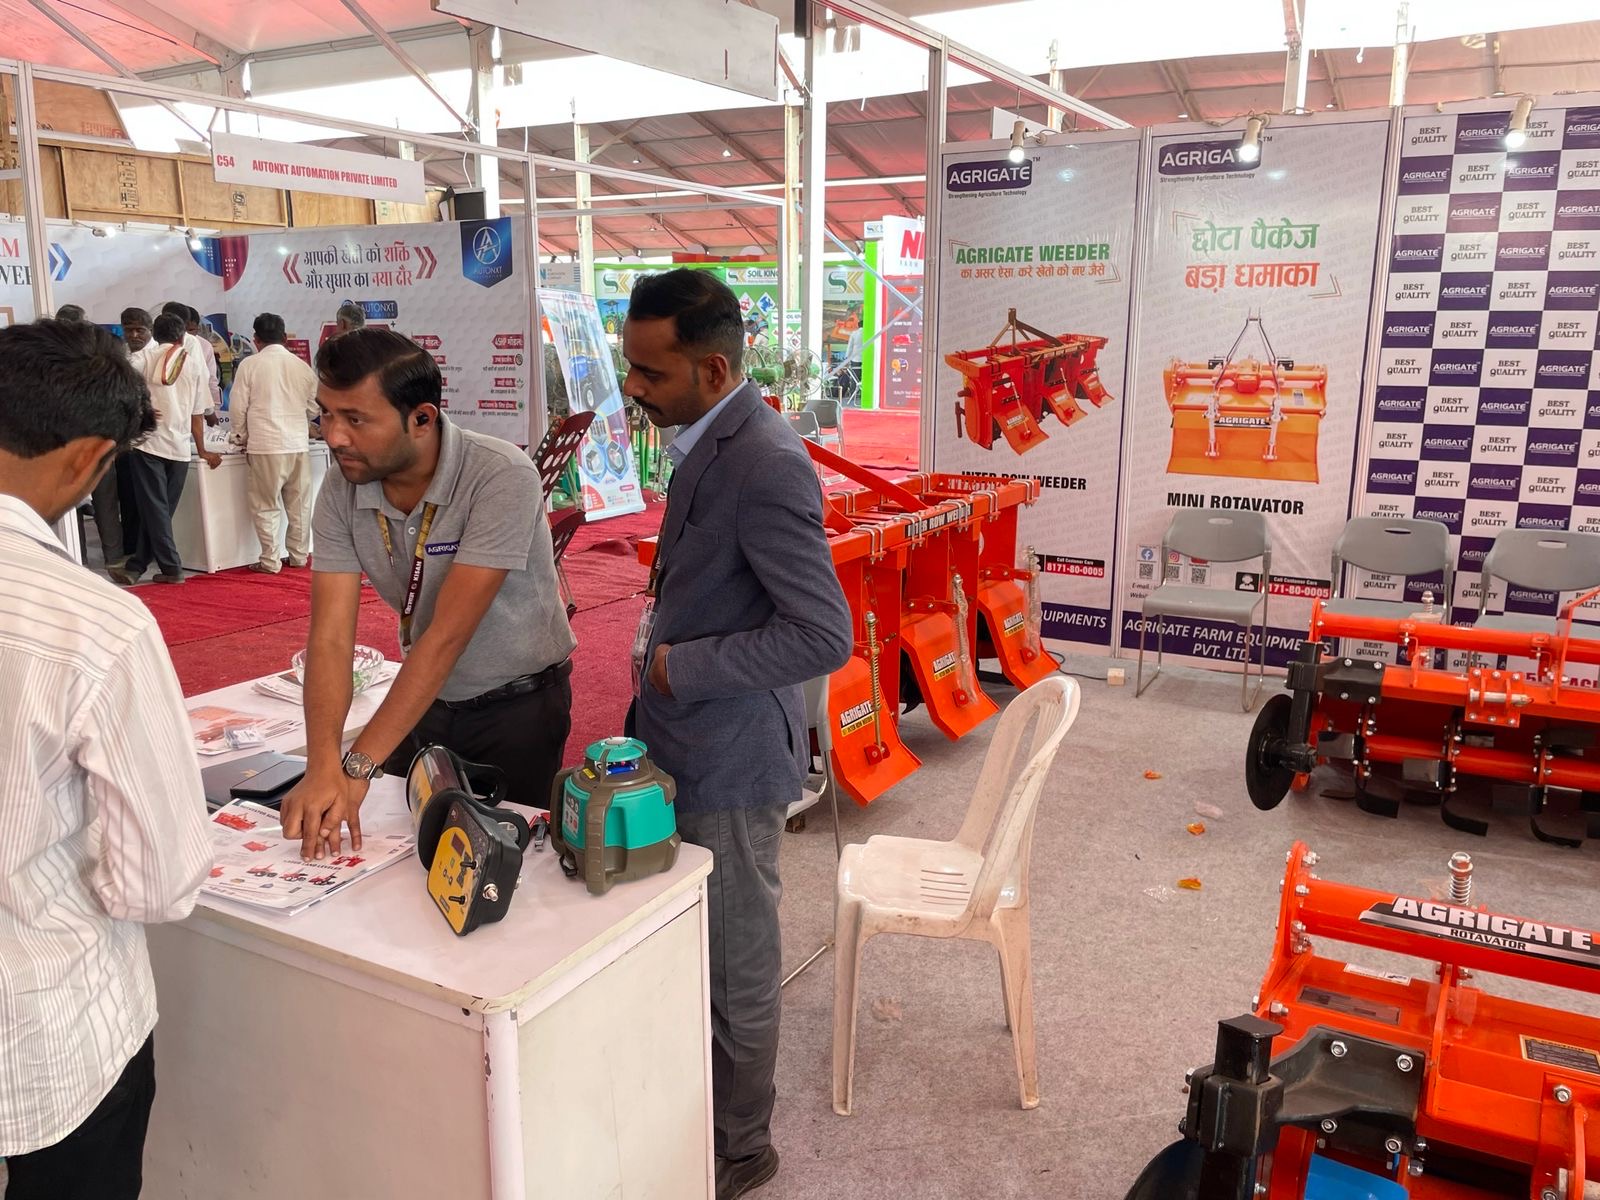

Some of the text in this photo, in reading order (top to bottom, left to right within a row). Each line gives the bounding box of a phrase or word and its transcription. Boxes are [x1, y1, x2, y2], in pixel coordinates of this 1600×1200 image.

[1567, 123, 1600, 132] AGRIGA
[1459, 128, 1504, 137] AGRIGATE
[1412, 135, 1447, 145] QUALITY
[216, 154, 235, 168] C54
[1162, 148, 1258, 168] AGRIGA
[252, 160, 398, 188] AUTONXT AUTOMATION PRIVATE LIMITED
[949, 166, 1030, 184] AGRIGATE
[1403, 171, 1447, 180] AGRIGATE
[1508, 167, 1554, 175] AGRIGATE
[1568, 170, 1600, 179] QUALIT
[1459, 173, 1495, 183] QUALITY
[1451, 208, 1495, 216] AGRIGATE
[1509, 211, 1545, 221] QUALITY
[1403, 215, 1438, 223] QUALITY
[1191, 217, 1320, 251] छोटा पैकेज
[304, 245, 338, 266] आपकी
[365, 242, 381, 263] को
[956, 243, 1110, 264] AGRIGATE WEEDER
[1395, 249, 1438, 257] AGRIGATE
[1500, 247, 1545, 255] AGRIGATE
[1558, 251, 1596, 260] QUALITY
[1451, 252, 1487, 261] QUALITY
[748, 270, 762, 278] SOIL
[960, 268, 972, 278] का
[974, 268, 995, 279] असर
[1056, 264, 1068, 276] को
[305, 268, 323, 289] और
[324, 272, 352, 294] सुधार
[353, 272, 370, 288] का
[372, 271, 392, 287] नया
[1185, 262, 1320, 294] बड़ा धमाका
[1442, 287, 1487, 295] AGRIGATE
[1500, 291, 1537, 299] QUALITY
[1549, 287, 1596, 295] AGRIGATE
[1395, 292, 1430, 300] QUALITY
[1387, 326, 1430, 334] AGRIGATE
[1442, 330, 1478, 339] QUALITY
[1490, 326, 1536, 334] AGRIGATE
[1549, 331, 1587, 339] QUALITY
[1387, 367, 1422, 375] QUALITY
[1433, 363, 1477, 371] AGRIGATE
[1539, 365, 1585, 373] AGRIGATE
[1490, 369, 1527, 377] QUALITY
[1378, 400, 1421, 408] AGRIGATE
[1481, 403, 1526, 411] AGRIGATE
[1433, 406, 1469, 414] QUALITY
[1539, 409, 1576, 417] QUALITY
[1219, 416, 1266, 425] AGRIGATE
[1379, 441, 1413, 449] QUALITY
[1425, 439, 1468, 447] AGRIGATE
[1529, 442, 1575, 451] AGRIGATE
[1481, 444, 1517, 453] QUALITY
[1371, 472, 1413, 481] AGRIGATE
[1537, 477, 1560, 485] BEST
[1425, 479, 1459, 488] QUALITY
[1471, 478, 1516, 486] AGRIGATE
[1528, 485, 1565, 493] QUALITY
[1167, 492, 1304, 515] MINI ROTAVATOR
[1378, 504, 1399, 512] BEST
[1416, 511, 1459, 519] AGRIGATE
[1472, 518, 1507, 527] QUALITY
[1520, 518, 1564, 527] AGRIGATE
[428, 544, 457, 553] AGRIGA
[1046, 562, 1103, 576] 8171-80-0005
[1364, 581, 1397, 590] QUALITY
[1408, 581, 1444, 590] AGRIGAT
[1268, 583, 1329, 598] 171-80-0005
[1510, 590, 1554, 600] AGRIGATE
[1041, 609, 1106, 628] UIPMENTS
[1124, 619, 1190, 637] AGRIGATE
[1192, 626, 1233, 642] FARM
[1193, 643, 1220, 658] PVT.
[1356, 648, 1389, 658] QUALITY
[1392, 896, 1592, 950] AGRIGATE
[1450, 928, 1527, 950] ROTAVATOR
